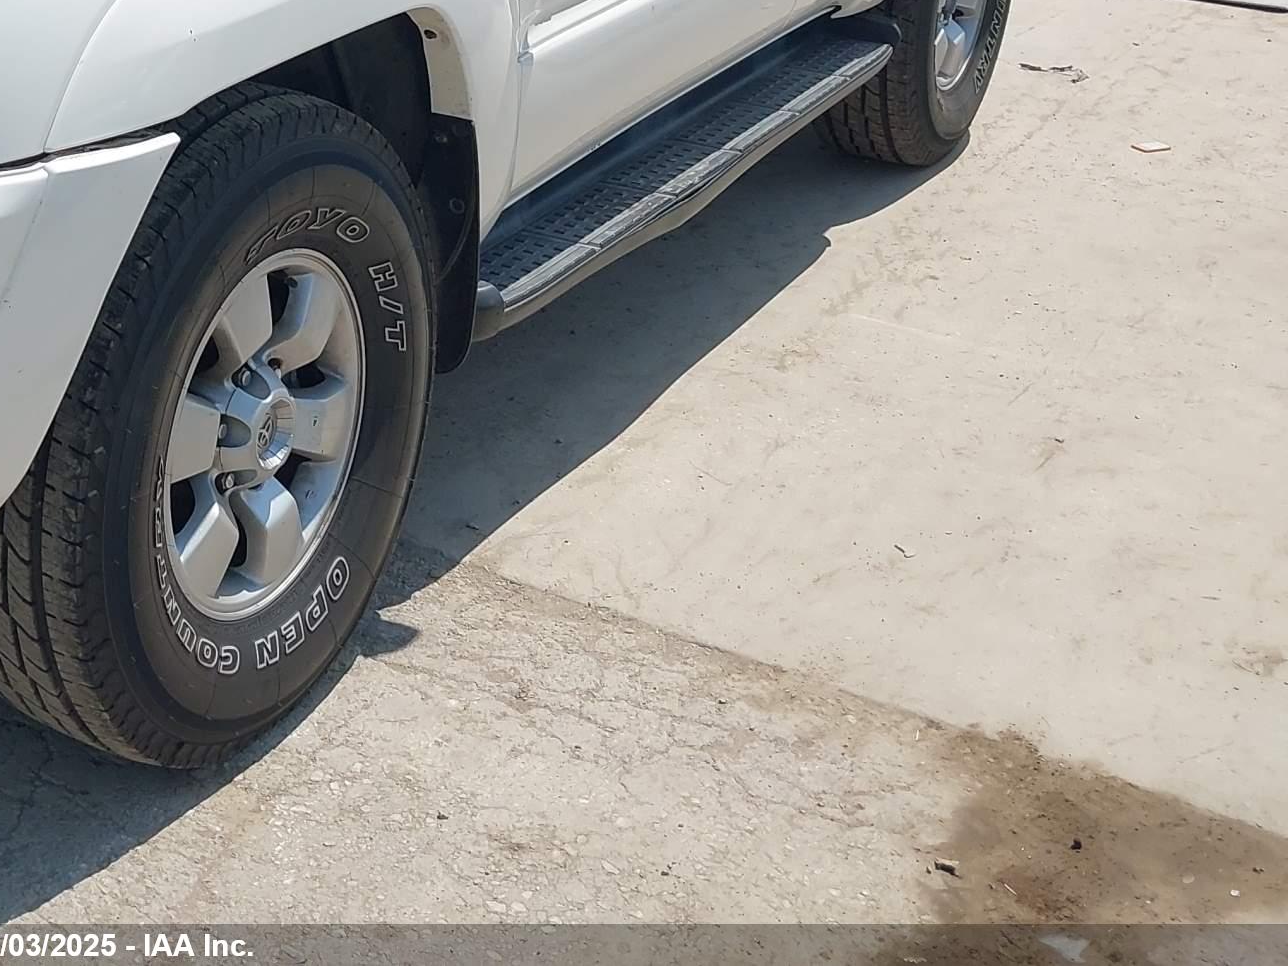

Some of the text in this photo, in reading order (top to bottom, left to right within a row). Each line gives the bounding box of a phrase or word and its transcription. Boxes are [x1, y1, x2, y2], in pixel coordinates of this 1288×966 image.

[245, 207, 370, 265] TOYO
[368, 261, 407, 352] H/T
[154, 455, 241, 675] COUNTRY
[255, 556, 350, 670] OPEN
